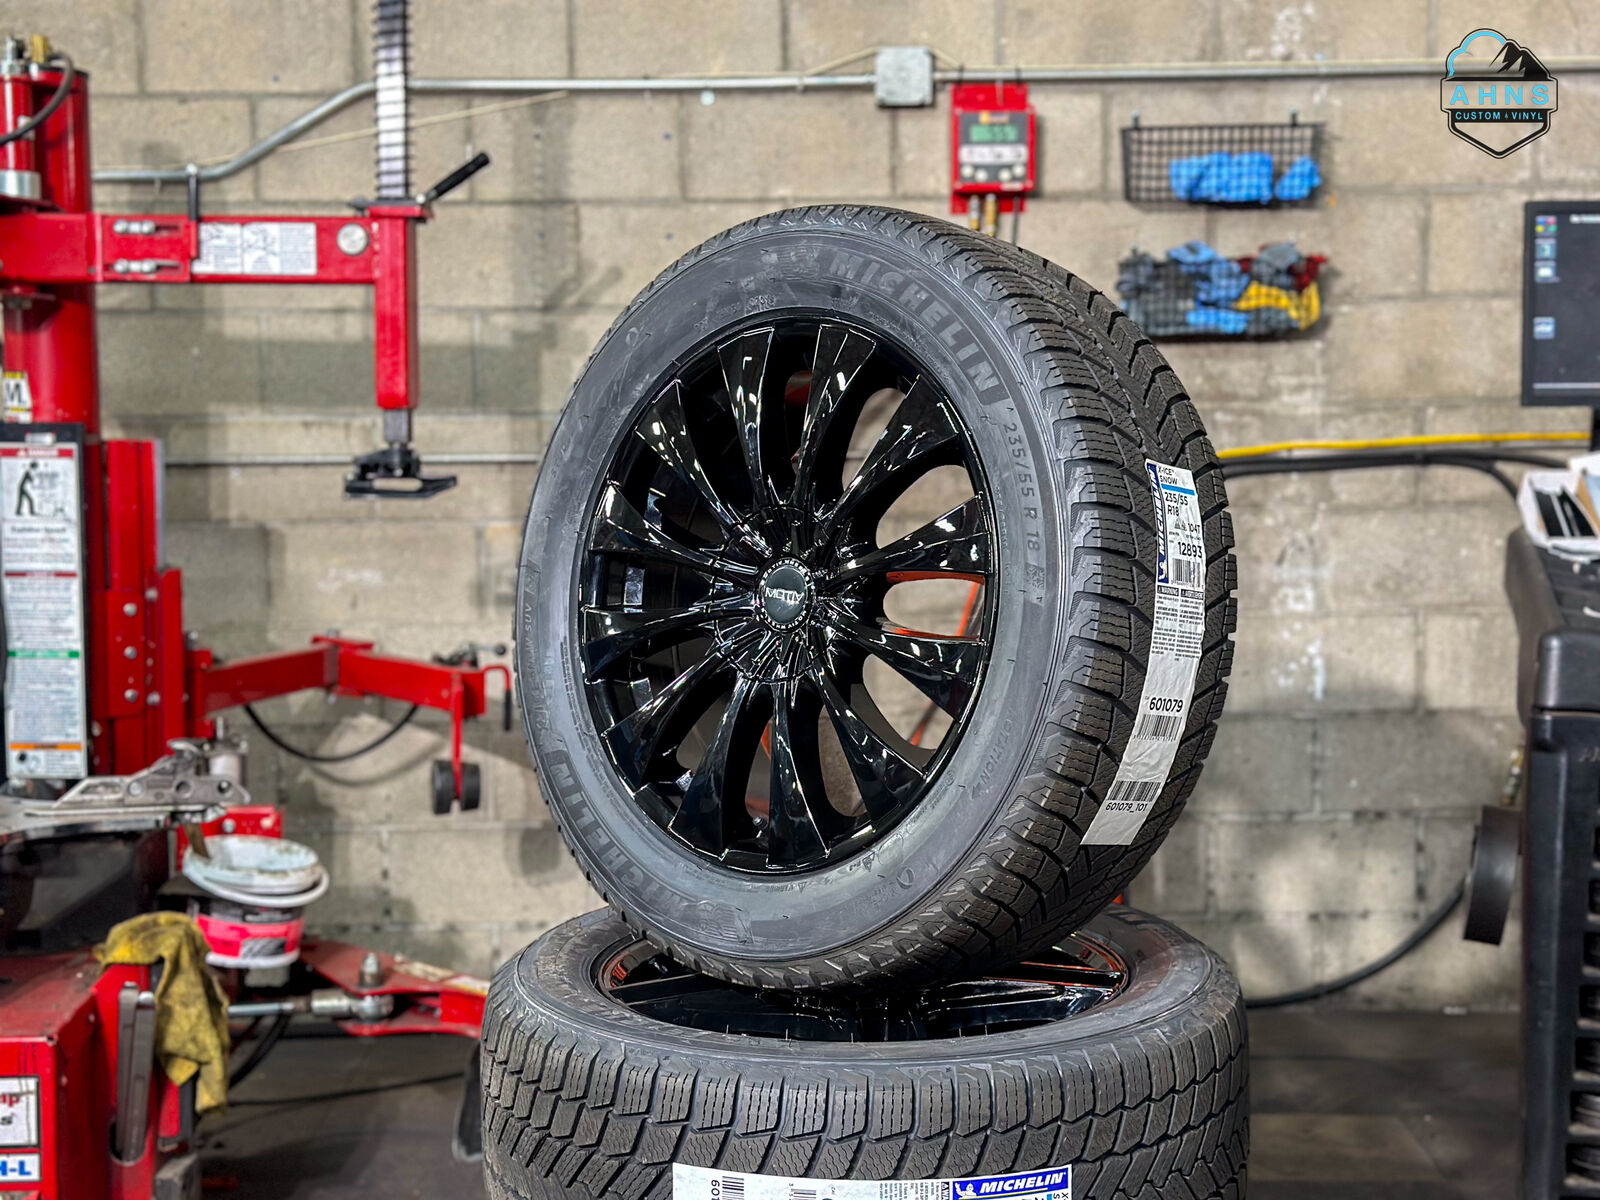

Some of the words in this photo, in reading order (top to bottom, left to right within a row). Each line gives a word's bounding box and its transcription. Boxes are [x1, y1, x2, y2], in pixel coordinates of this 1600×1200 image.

[829, 256, 1000, 390] MICHELIN
[1003, 422, 1035, 497] 235/55
[1160, 475, 1178, 485] SNOW
[1164, 491, 1189, 506] 235/55
[1024, 507, 1038, 519] R
[1148, 469, 1166, 555] MICHELIN
[1167, 504, 1180, 517] R18
[1027, 530, 1041, 552] 18
[1177, 541, 1203, 559] 12893
[1149, 697, 1184, 713] 601079
[1105, 801, 1148, 813] 601079_101
[549, 763, 684, 910] MICHELIN
[979, 1172, 1064, 1194] MICHELIN
